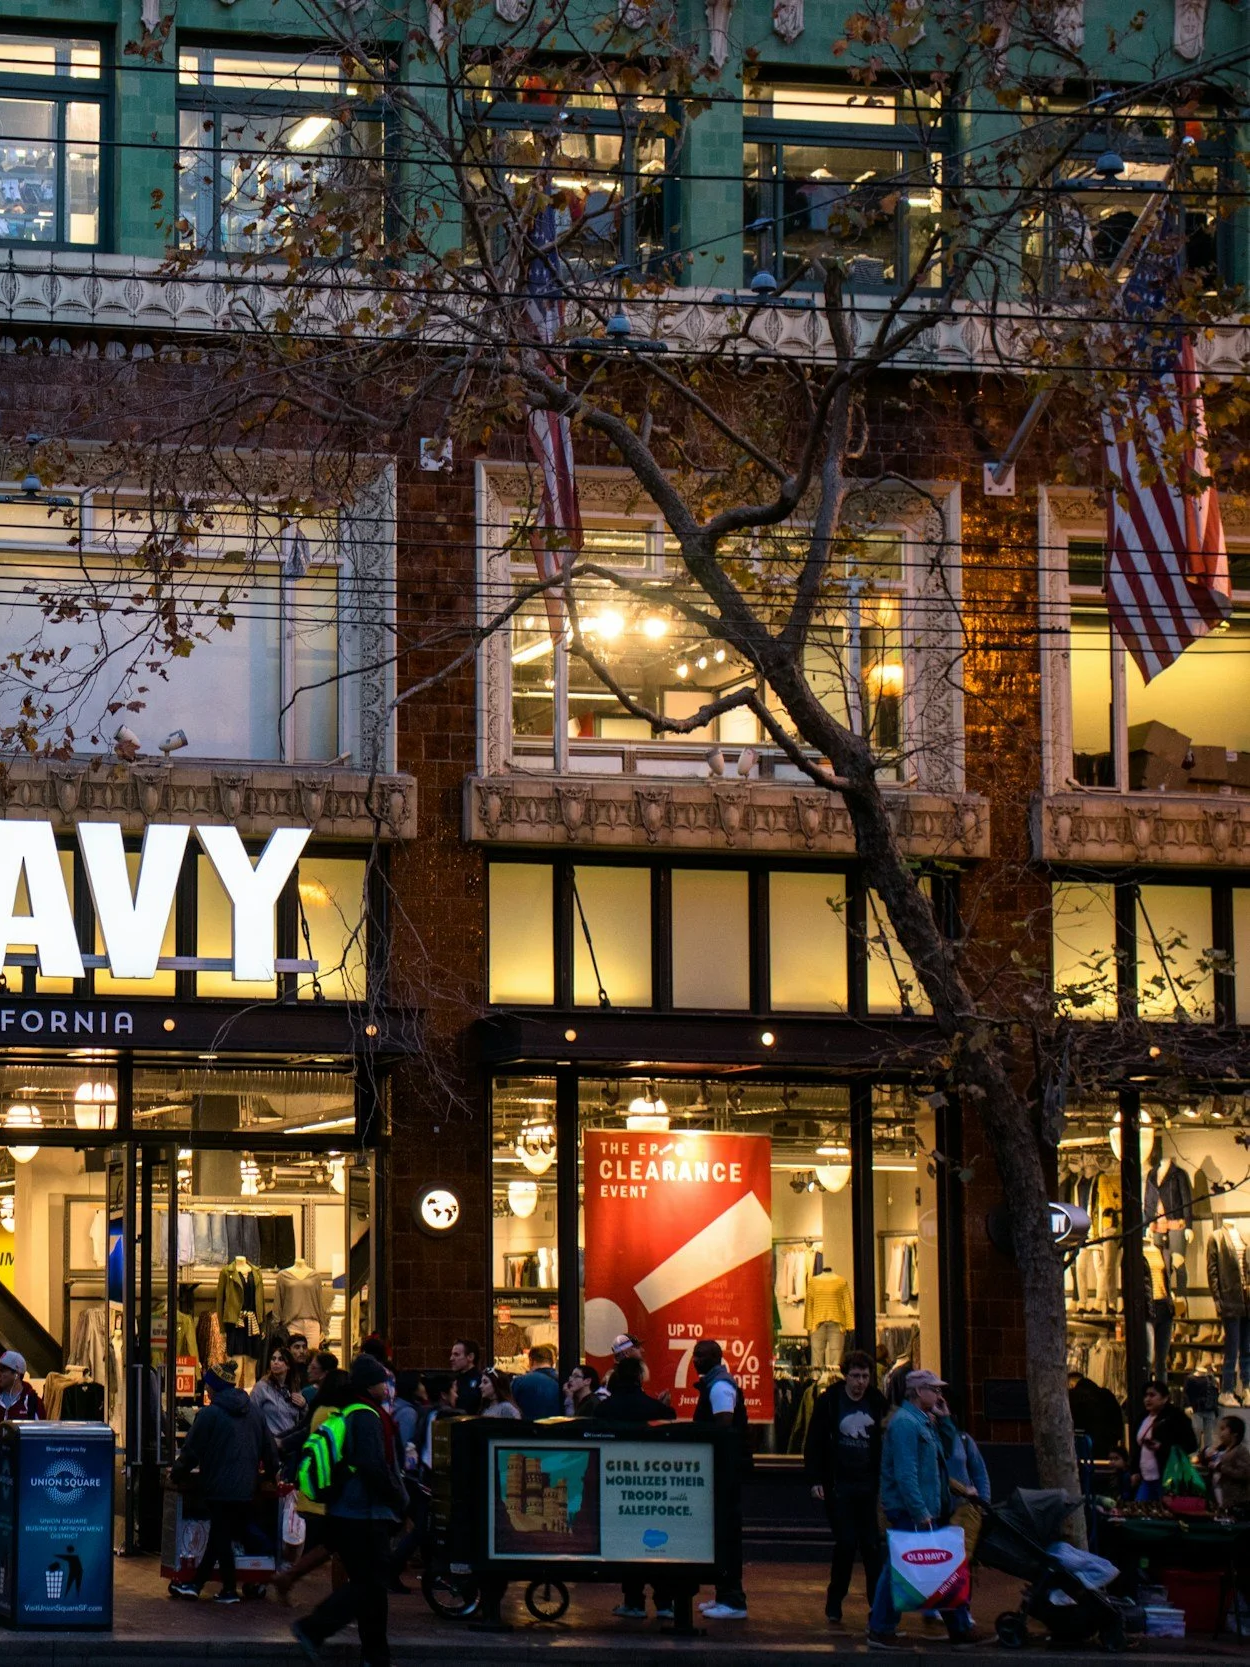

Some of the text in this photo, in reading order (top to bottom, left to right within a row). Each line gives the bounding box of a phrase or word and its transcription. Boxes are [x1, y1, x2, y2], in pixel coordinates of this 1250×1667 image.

[600, 1142, 629, 1155] THE
[599, 1159, 742, 1183] CLEARANCE
[600, 1185, 648, 1198] EVENT
[668, 1324, 703, 1337] UP TO
[605, 1460, 700, 1473] GIRL SCOUTS
[30, 1478, 101, 1488] UNION SQUARE
[605, 1475, 705, 1487] MOBILIZES THEIR
[620, 1490, 668, 1500] TROOPS
[618, 1505, 693, 1516] SALESFORCE.
[907, 1552, 947, 1561] OLD NAVY
[24, 1604, 103, 1612] VisitUnionSquareSF.com
